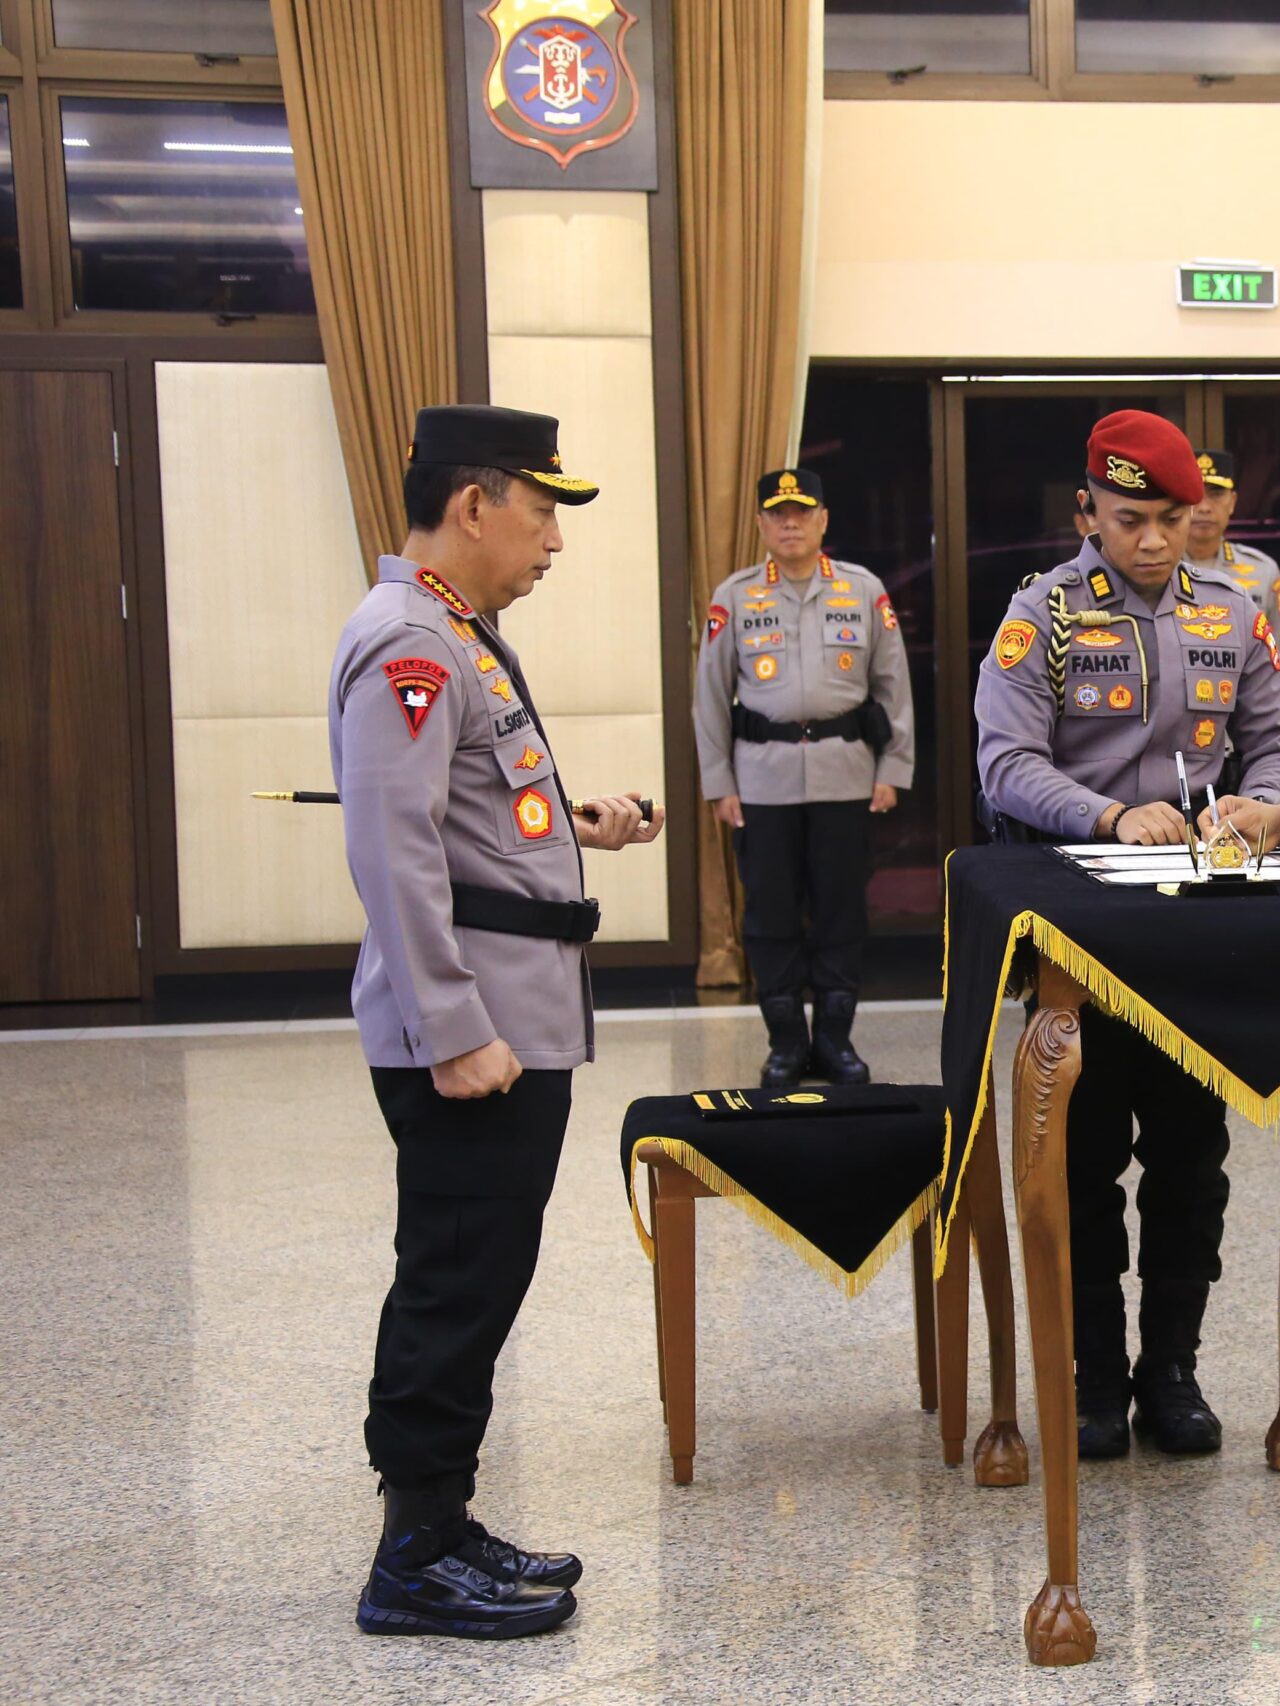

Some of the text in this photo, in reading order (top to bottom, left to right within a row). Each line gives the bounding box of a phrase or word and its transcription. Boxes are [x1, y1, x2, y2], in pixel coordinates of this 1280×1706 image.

[1193, 273, 1263, 301] EXIT
[744, 617, 779, 630] DEDI
[825, 612, 862, 623] POLRI
[1071, 654, 1131, 673] FAHAT
[1188, 649, 1236, 669] POLRI
